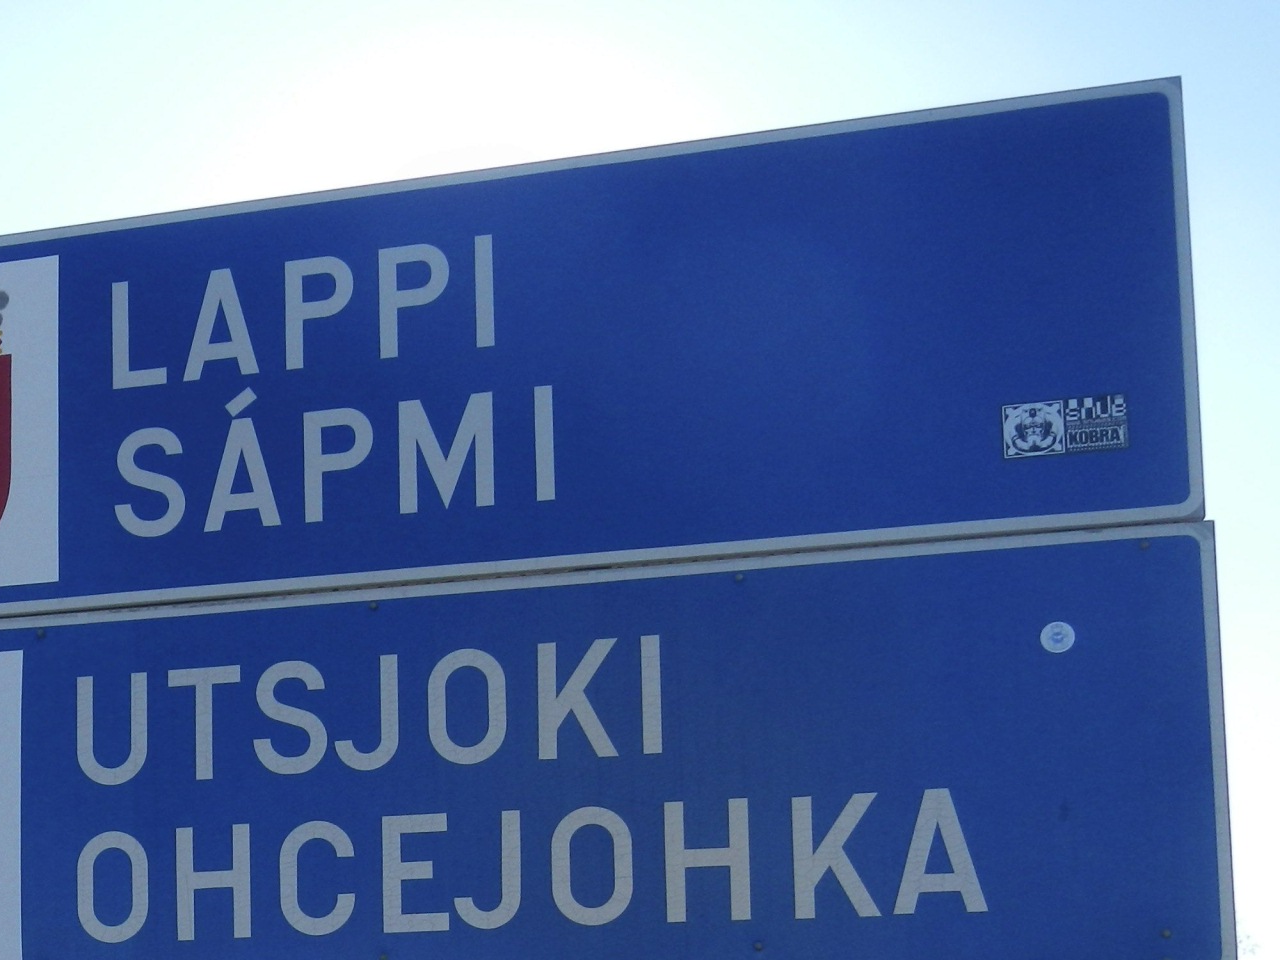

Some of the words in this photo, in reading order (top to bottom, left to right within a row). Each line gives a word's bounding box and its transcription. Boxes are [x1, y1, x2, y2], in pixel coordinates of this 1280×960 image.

[111, 234, 496, 390] LAPPI
[114, 385, 557, 538] SÁPMI
[1069, 428, 1121, 446] KOBRA
[76, 634, 664, 786] UTSJOKI
[76, 787, 989, 944] OHCEJOHKA
